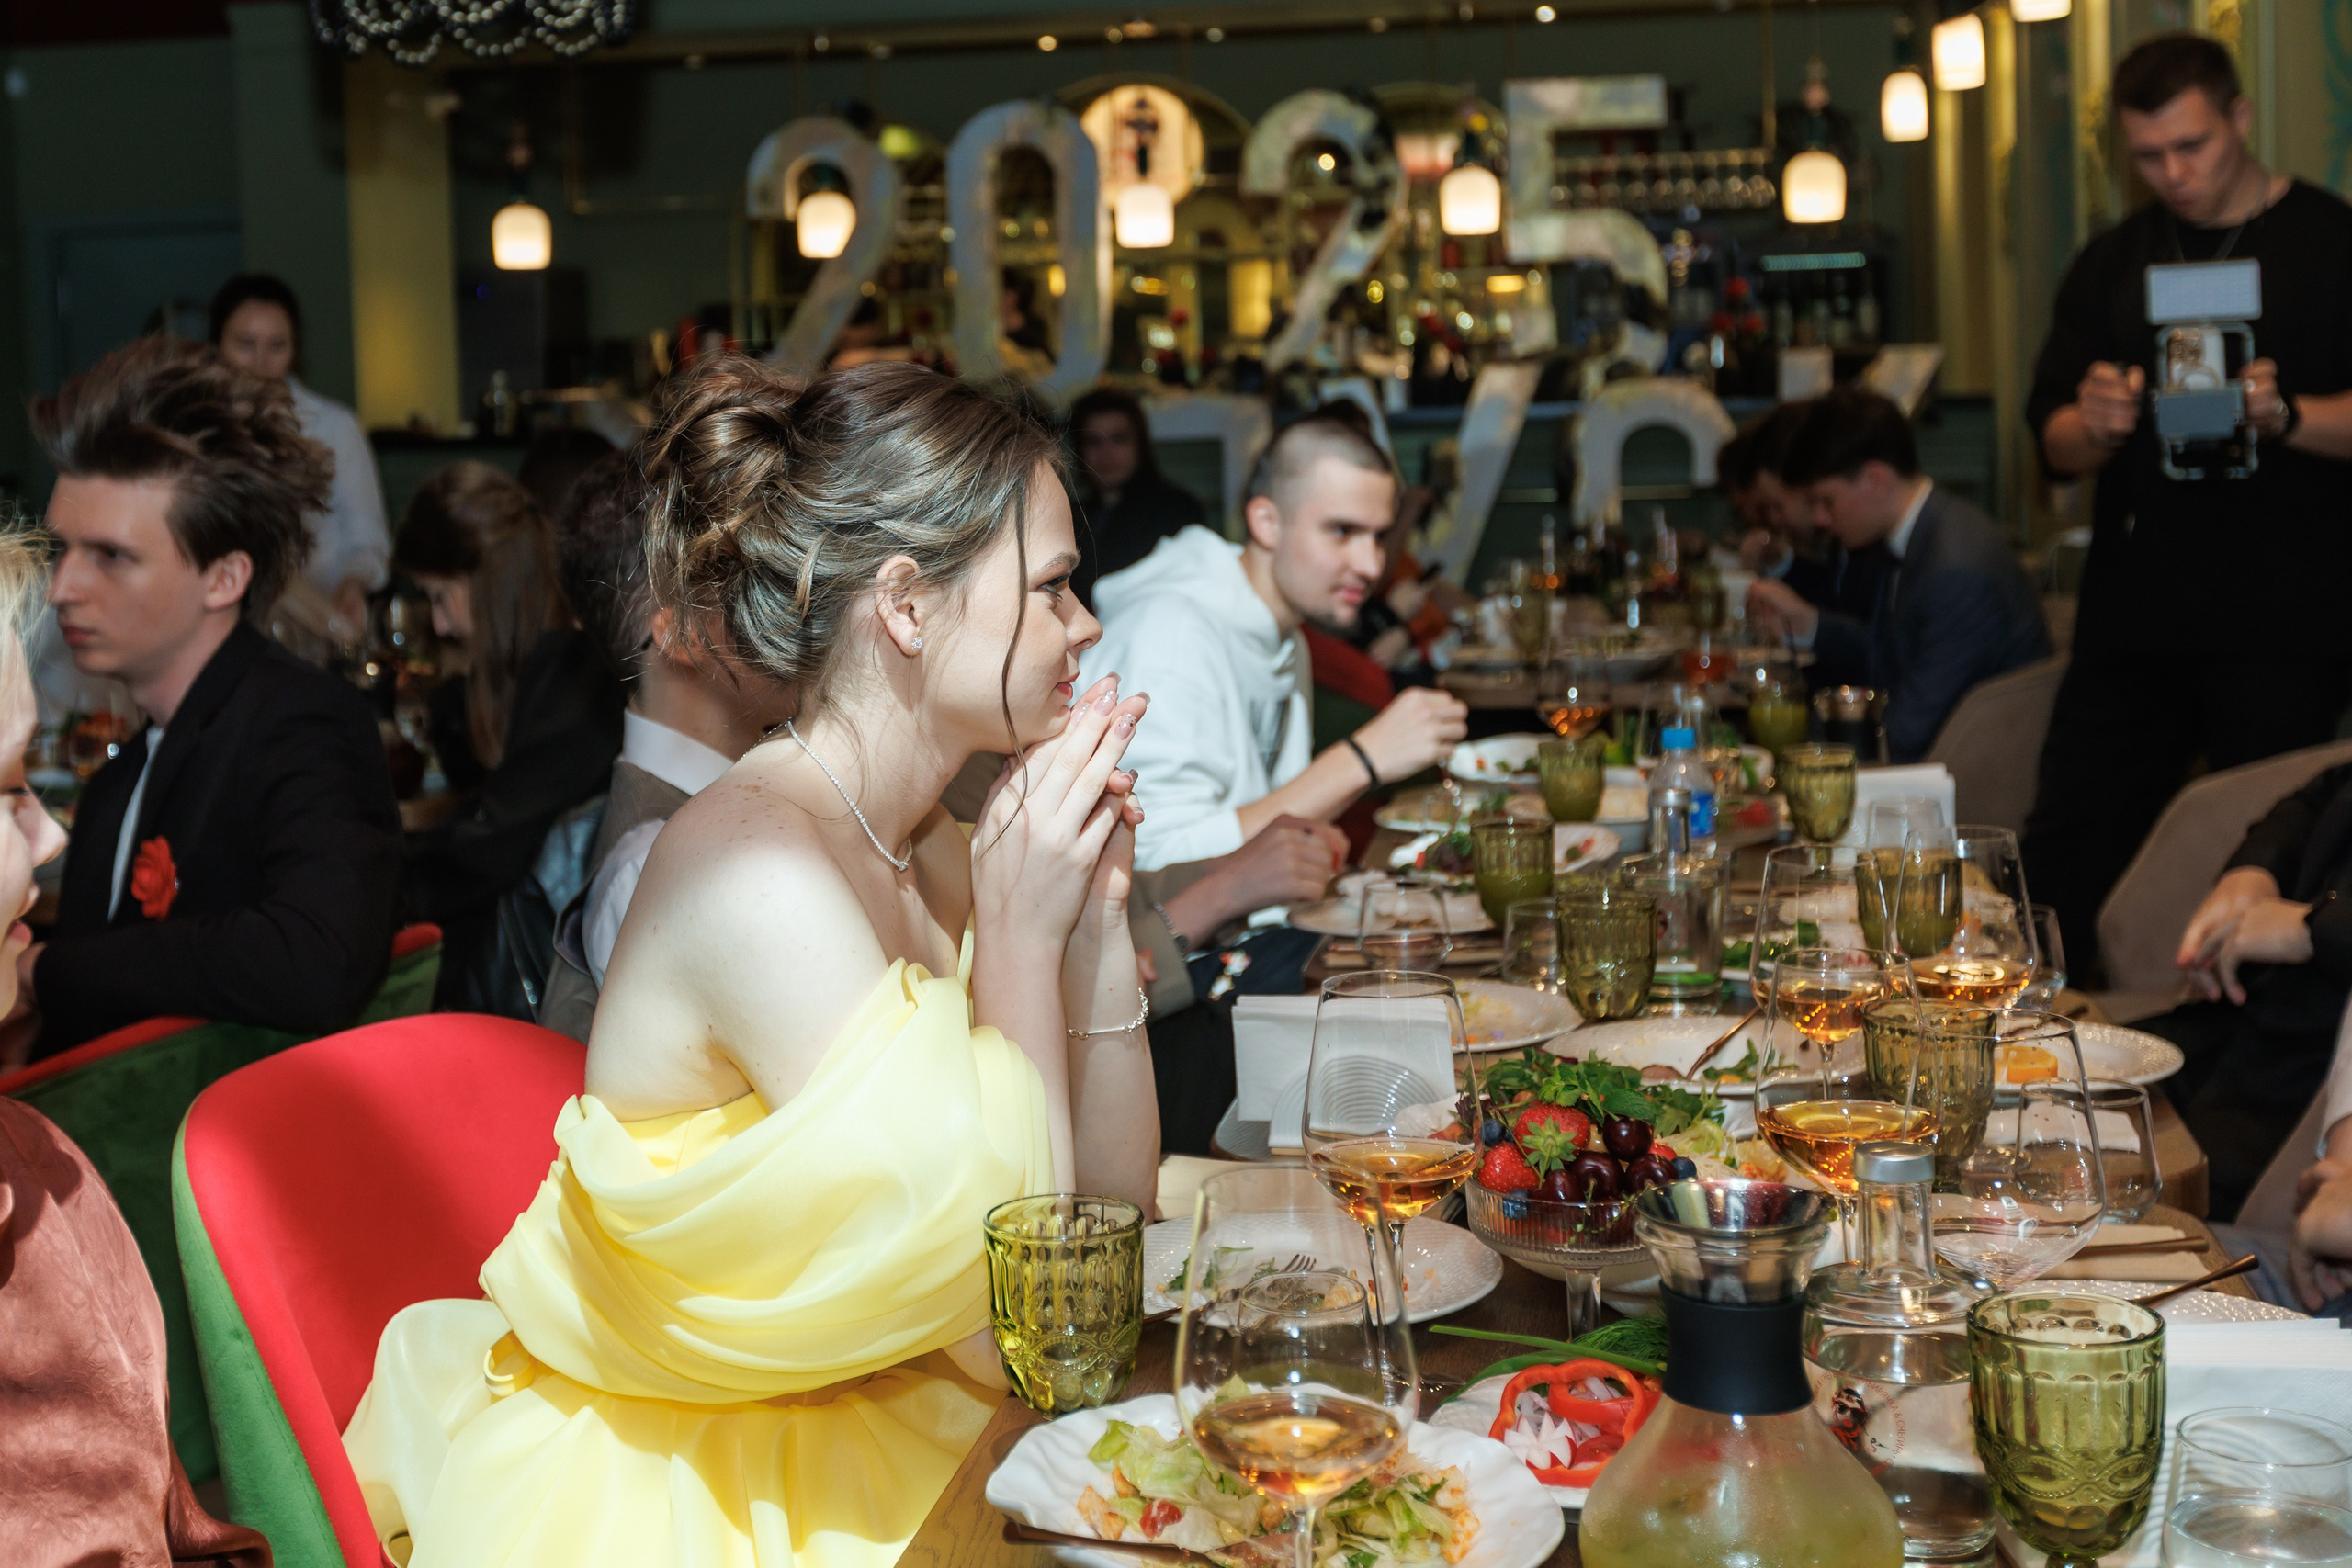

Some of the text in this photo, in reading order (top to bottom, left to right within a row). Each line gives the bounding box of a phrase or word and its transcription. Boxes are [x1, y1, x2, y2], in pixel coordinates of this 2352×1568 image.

[746, 73, 1669, 407] 2025
[1862, 1379, 1899, 1413] БИРЯЧКА
[1892, 1419, 1907, 1455] СНЕГИРЬ
